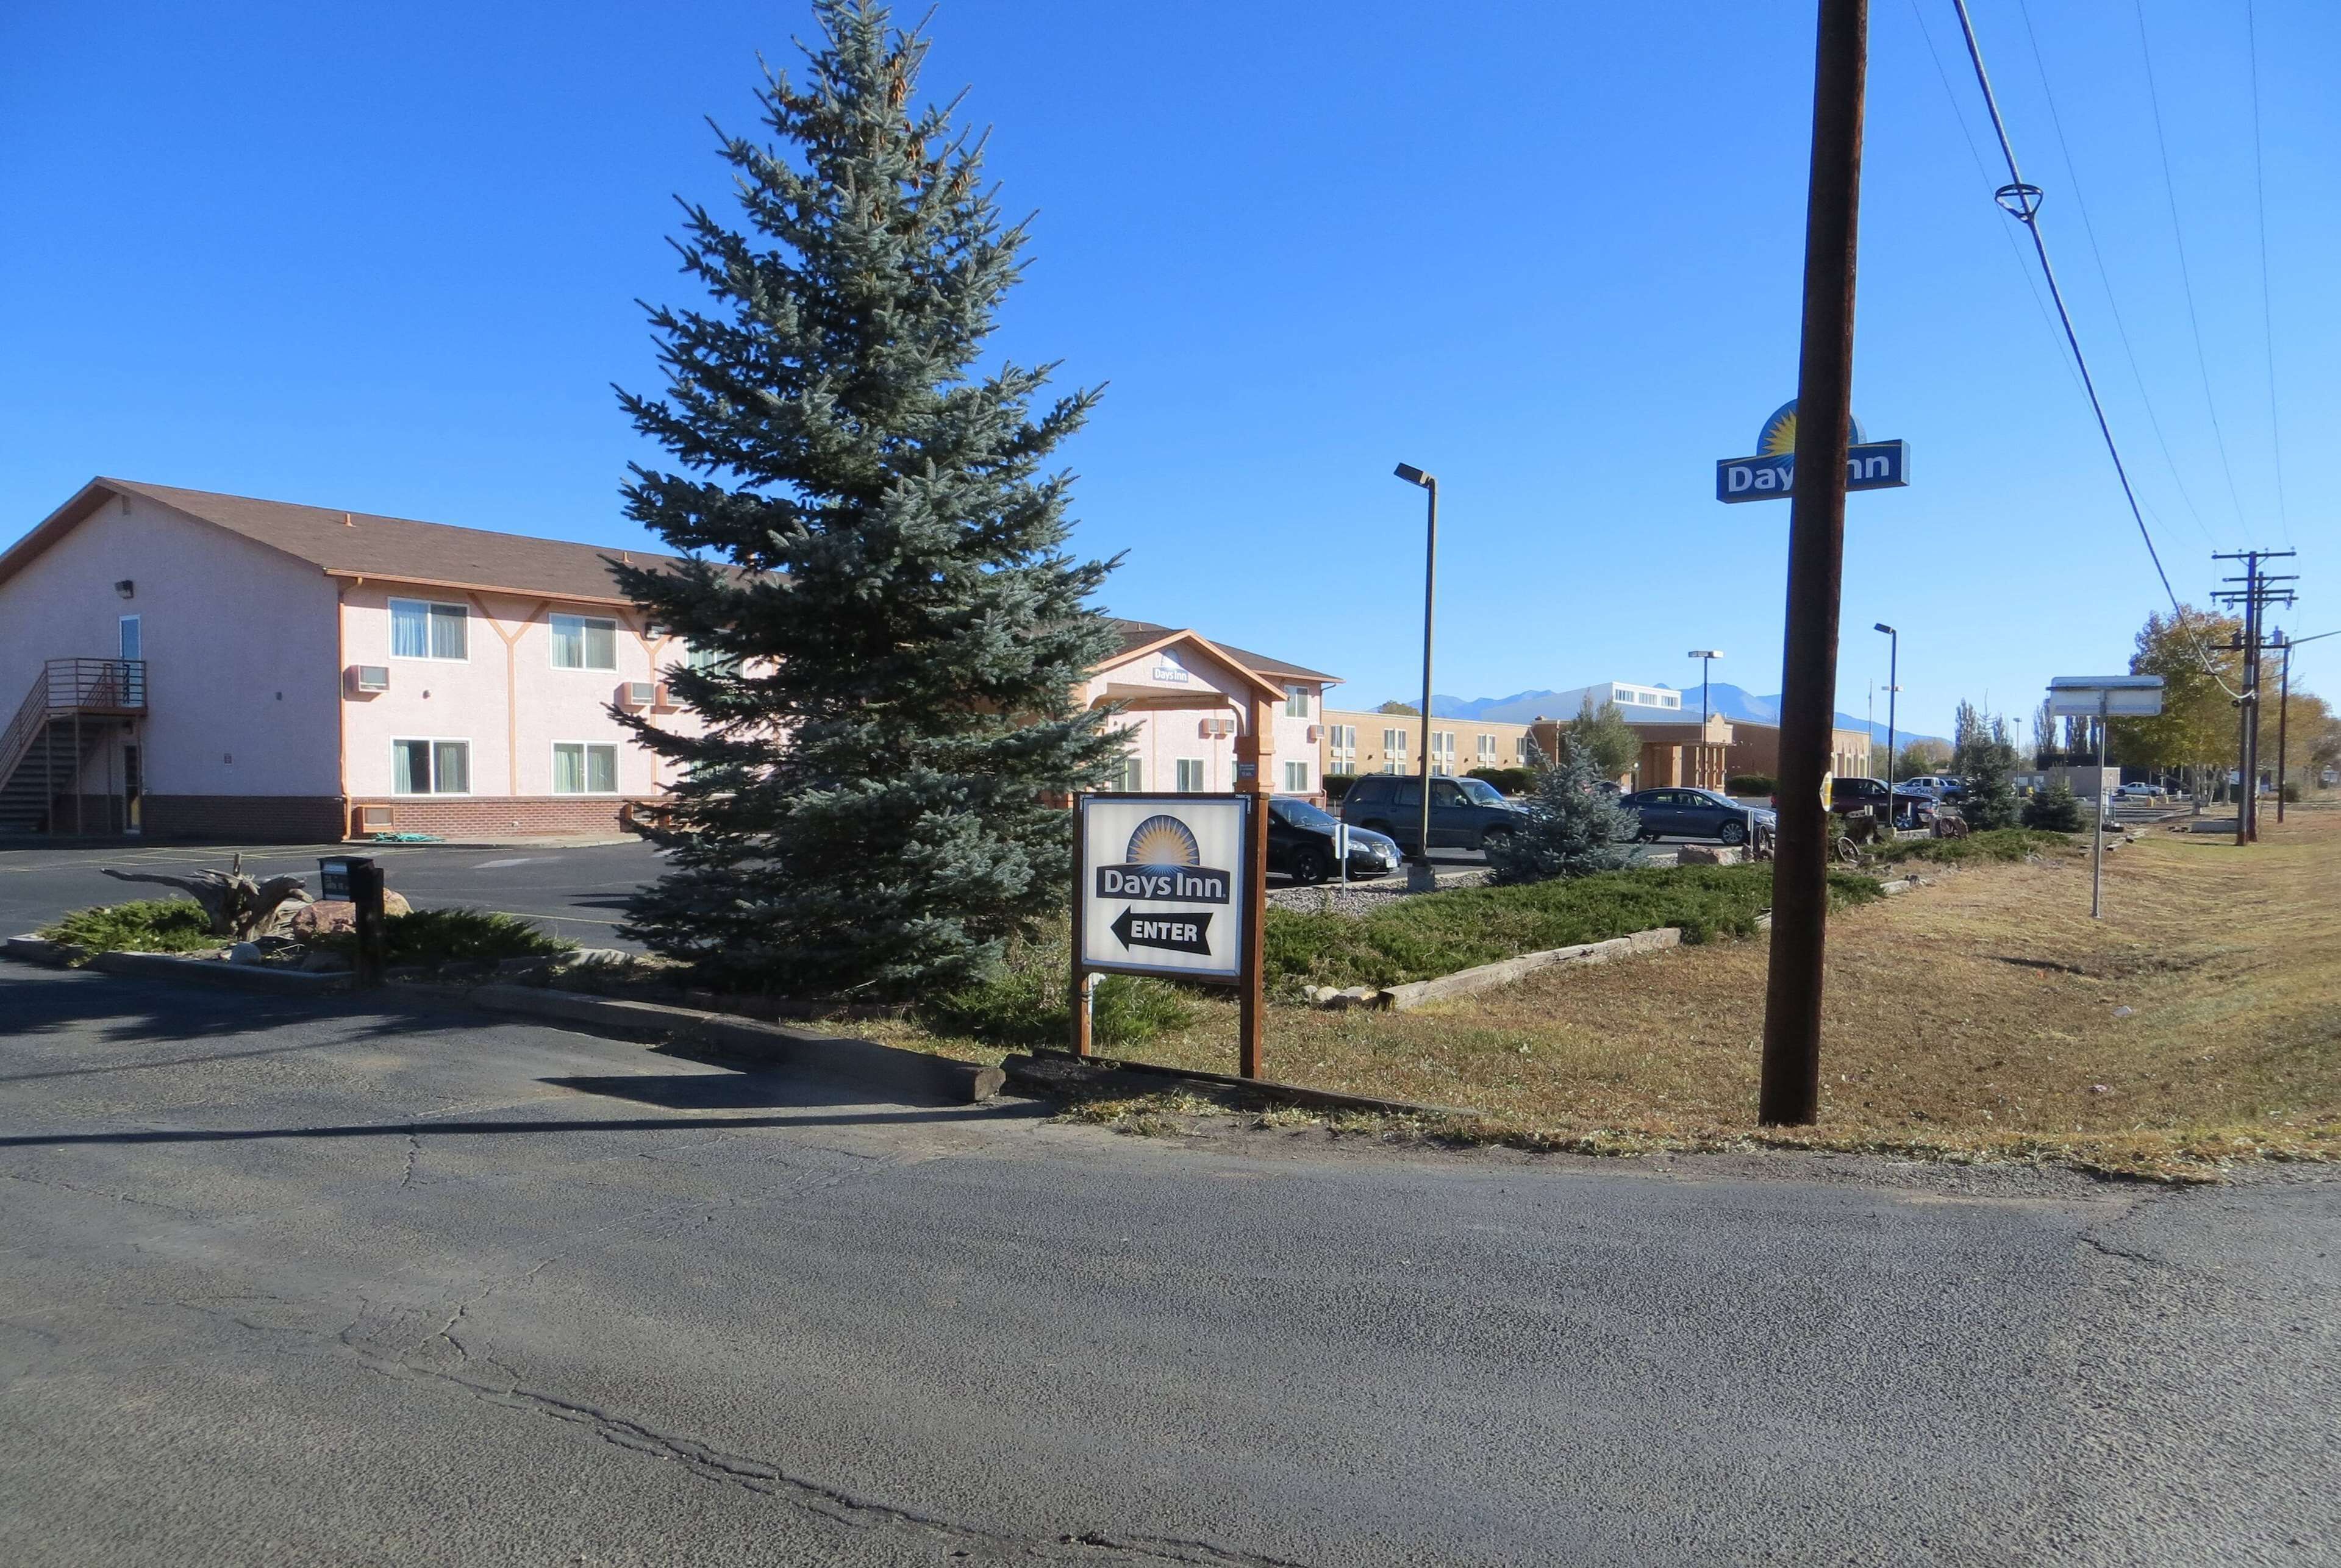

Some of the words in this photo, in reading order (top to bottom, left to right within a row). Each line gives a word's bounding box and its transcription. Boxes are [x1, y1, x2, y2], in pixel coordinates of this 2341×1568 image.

[1728, 466, 1793, 492] Day
[1846, 455, 1889, 480] nn
[1155, 669, 1173, 680] Days
[1174, 671, 1187, 681] Inn
[1104, 869, 1171, 898] Days
[1176, 872, 1222, 898] Inn
[1131, 919, 1198, 942] ENTER
